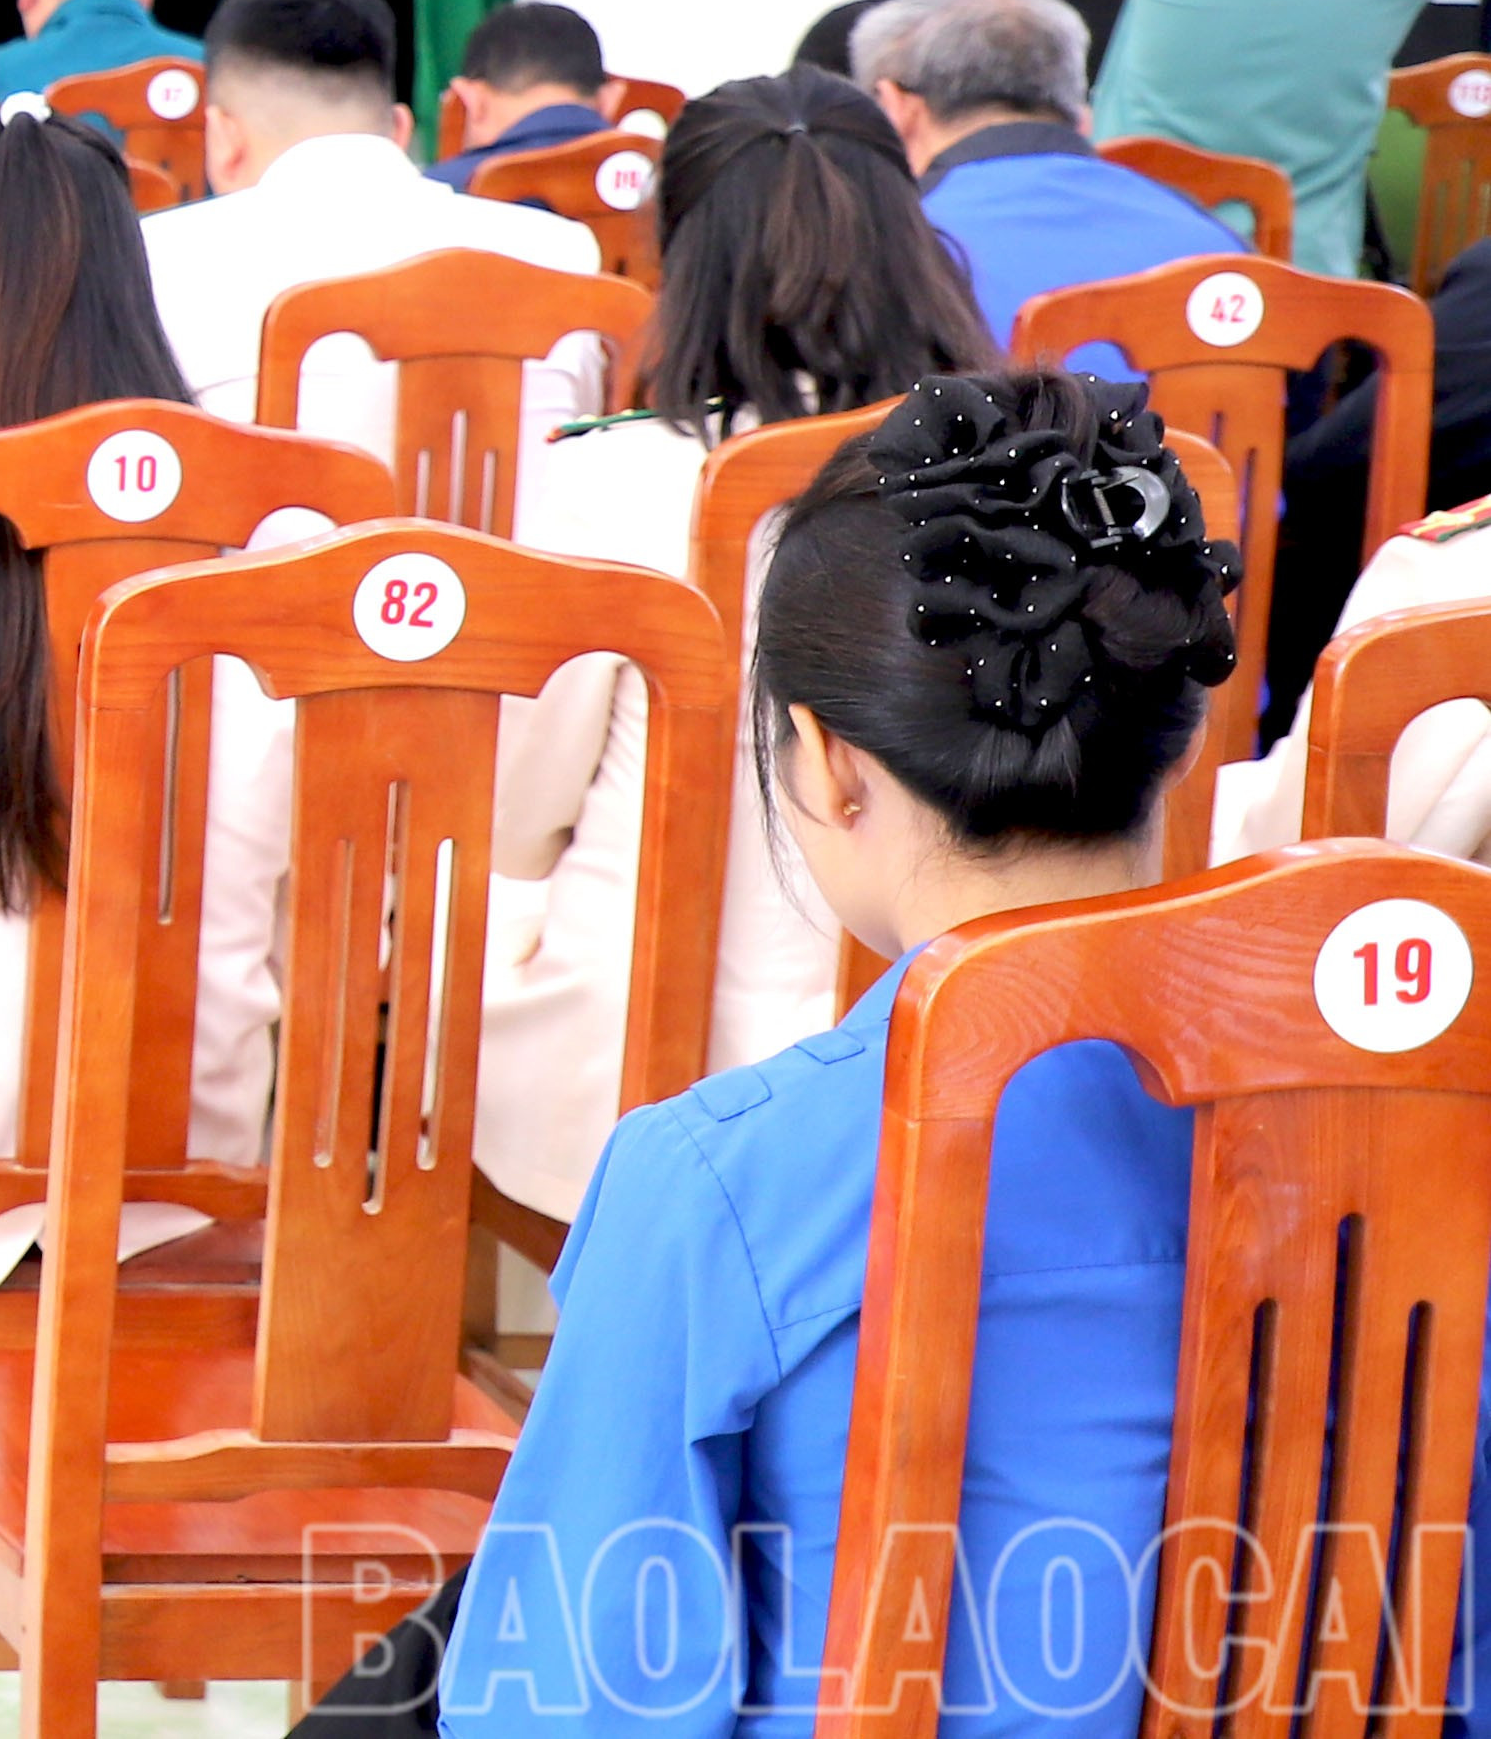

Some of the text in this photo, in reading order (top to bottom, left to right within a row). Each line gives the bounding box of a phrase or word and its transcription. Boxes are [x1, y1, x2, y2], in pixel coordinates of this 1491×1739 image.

[1208, 294, 1247, 325] 42
[113, 454, 158, 493] 10
[380, 579, 437, 629] 82
[1352, 938, 1433, 1007] 19
